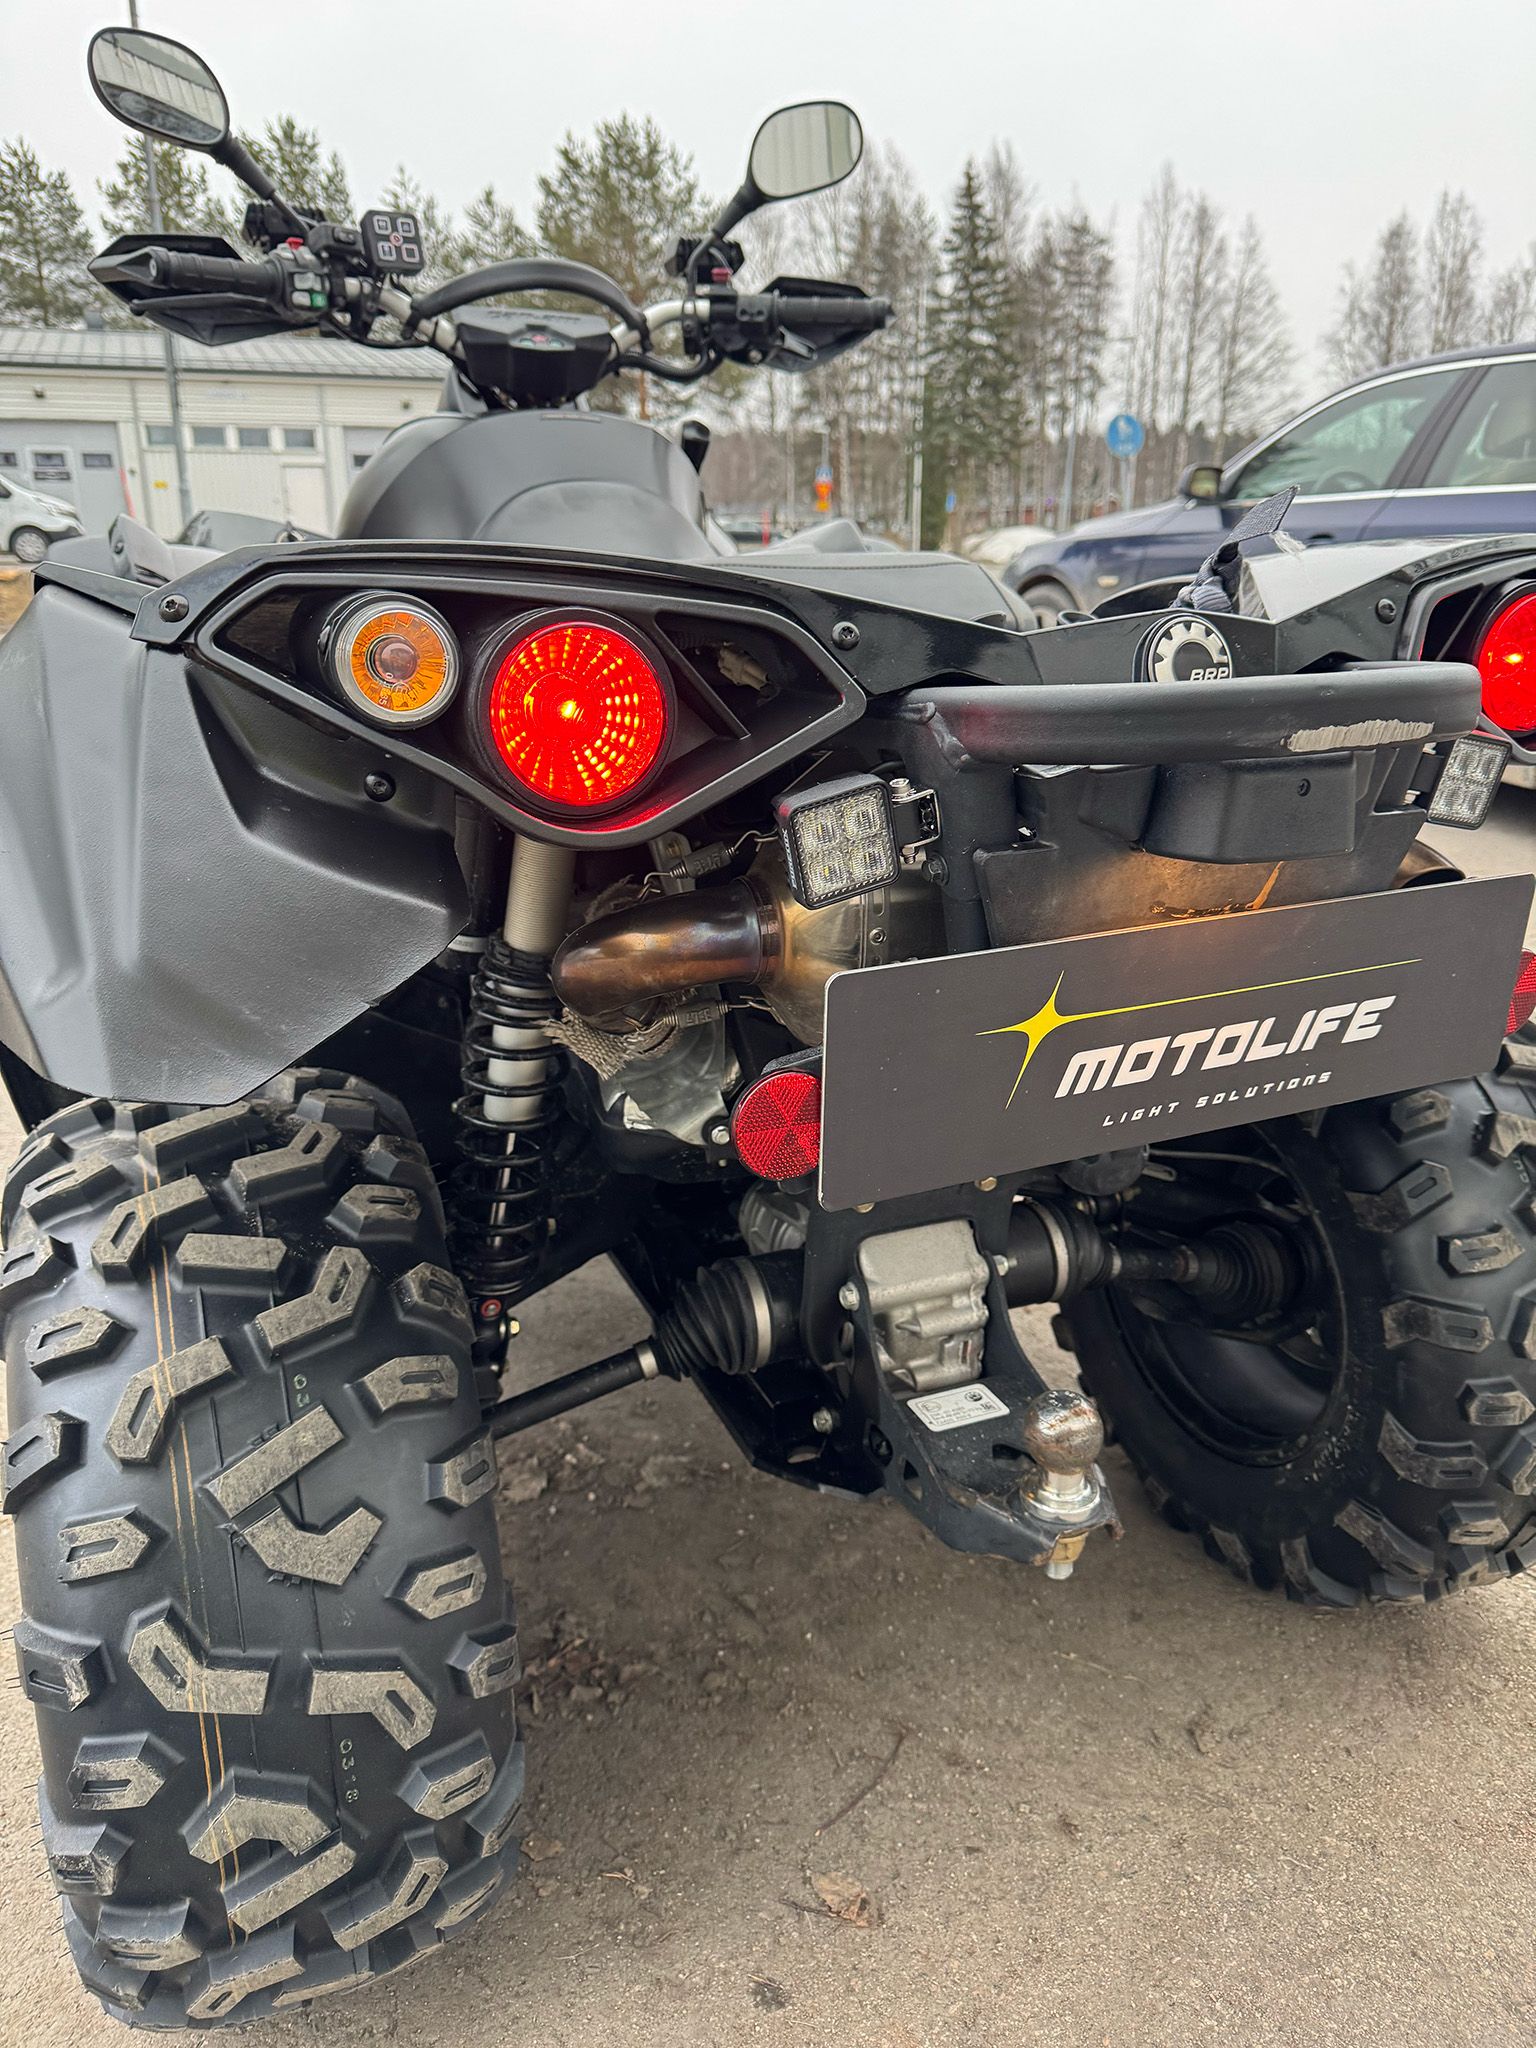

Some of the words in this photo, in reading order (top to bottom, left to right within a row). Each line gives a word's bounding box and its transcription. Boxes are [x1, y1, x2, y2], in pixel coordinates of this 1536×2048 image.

[1190, 667, 1229, 681] BRP
[1054, 995, 1397, 1099] MOTOLIFE
[1102, 1101, 1180, 1127] LIGHT
[1195, 1071, 1333, 1109] SOLUTIONS
